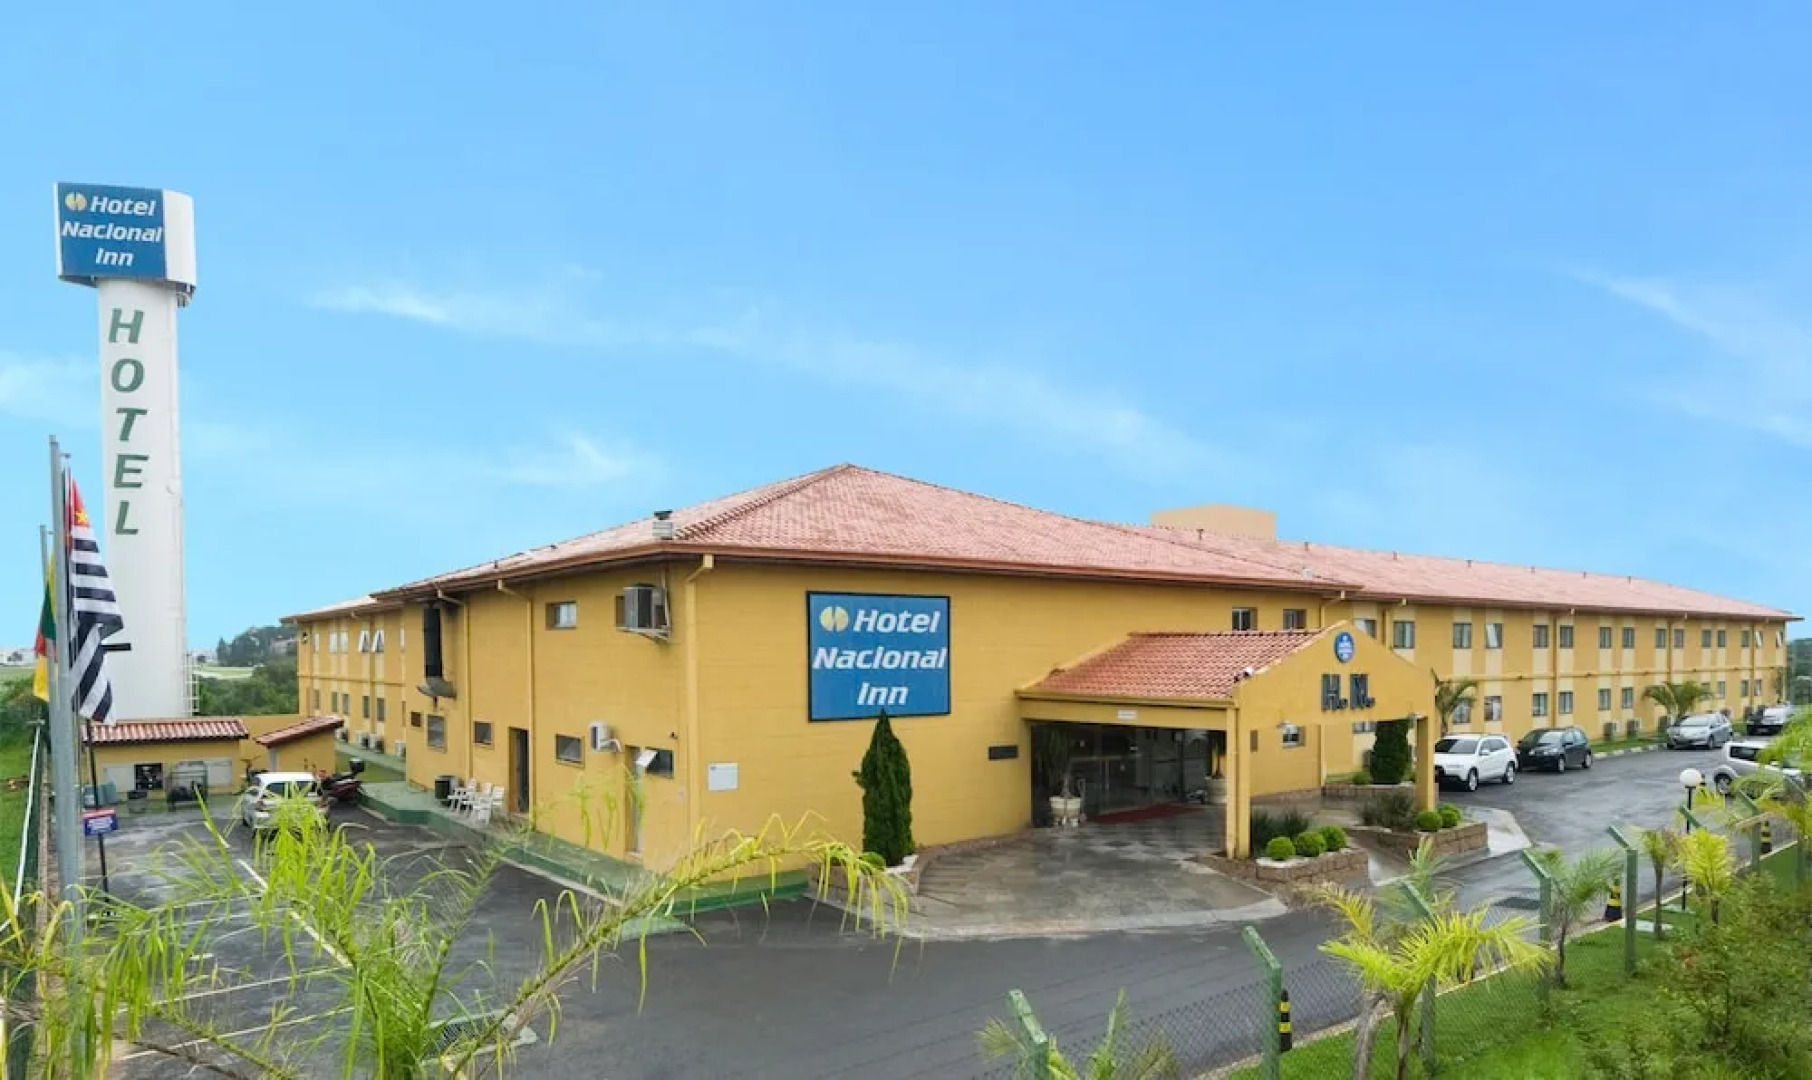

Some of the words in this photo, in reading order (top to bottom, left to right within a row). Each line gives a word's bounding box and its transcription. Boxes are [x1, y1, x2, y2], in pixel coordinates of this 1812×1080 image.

[89, 195, 157, 217] Hotel
[61, 220, 163, 243] Nacional
[95, 247, 135, 267] Inn
[108, 307, 149, 535] HOTEL
[852, 608, 941, 633] Hotel
[812, 645, 948, 670] Nacional
[856, 682, 909, 706] Inn
